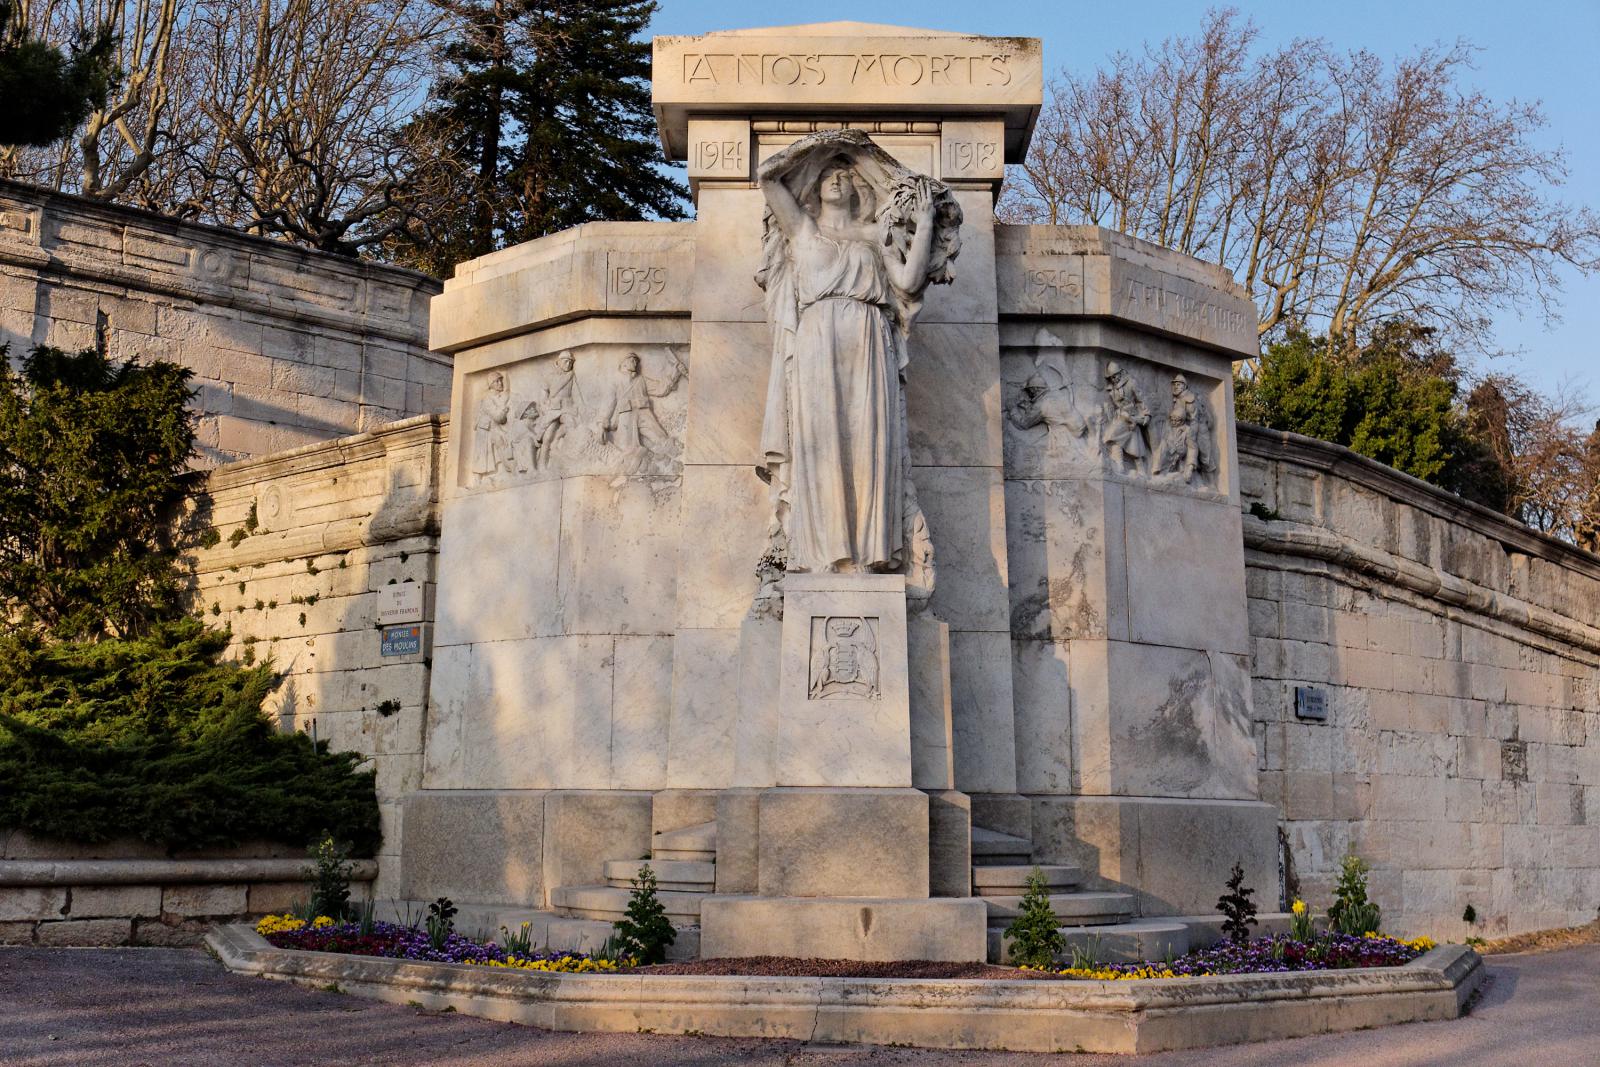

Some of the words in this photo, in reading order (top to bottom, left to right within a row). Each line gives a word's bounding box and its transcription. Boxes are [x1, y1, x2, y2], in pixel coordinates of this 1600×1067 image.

[688, 54, 720, 85] A
[737, 54, 826, 86] NOS
[851, 54, 1012, 86] MORTS
[694, 141, 742, 170] 1914
[949, 142, 997, 170] 1918
[611, 266, 667, 296] 1939
[1023, 269, 1081, 298] 1945
